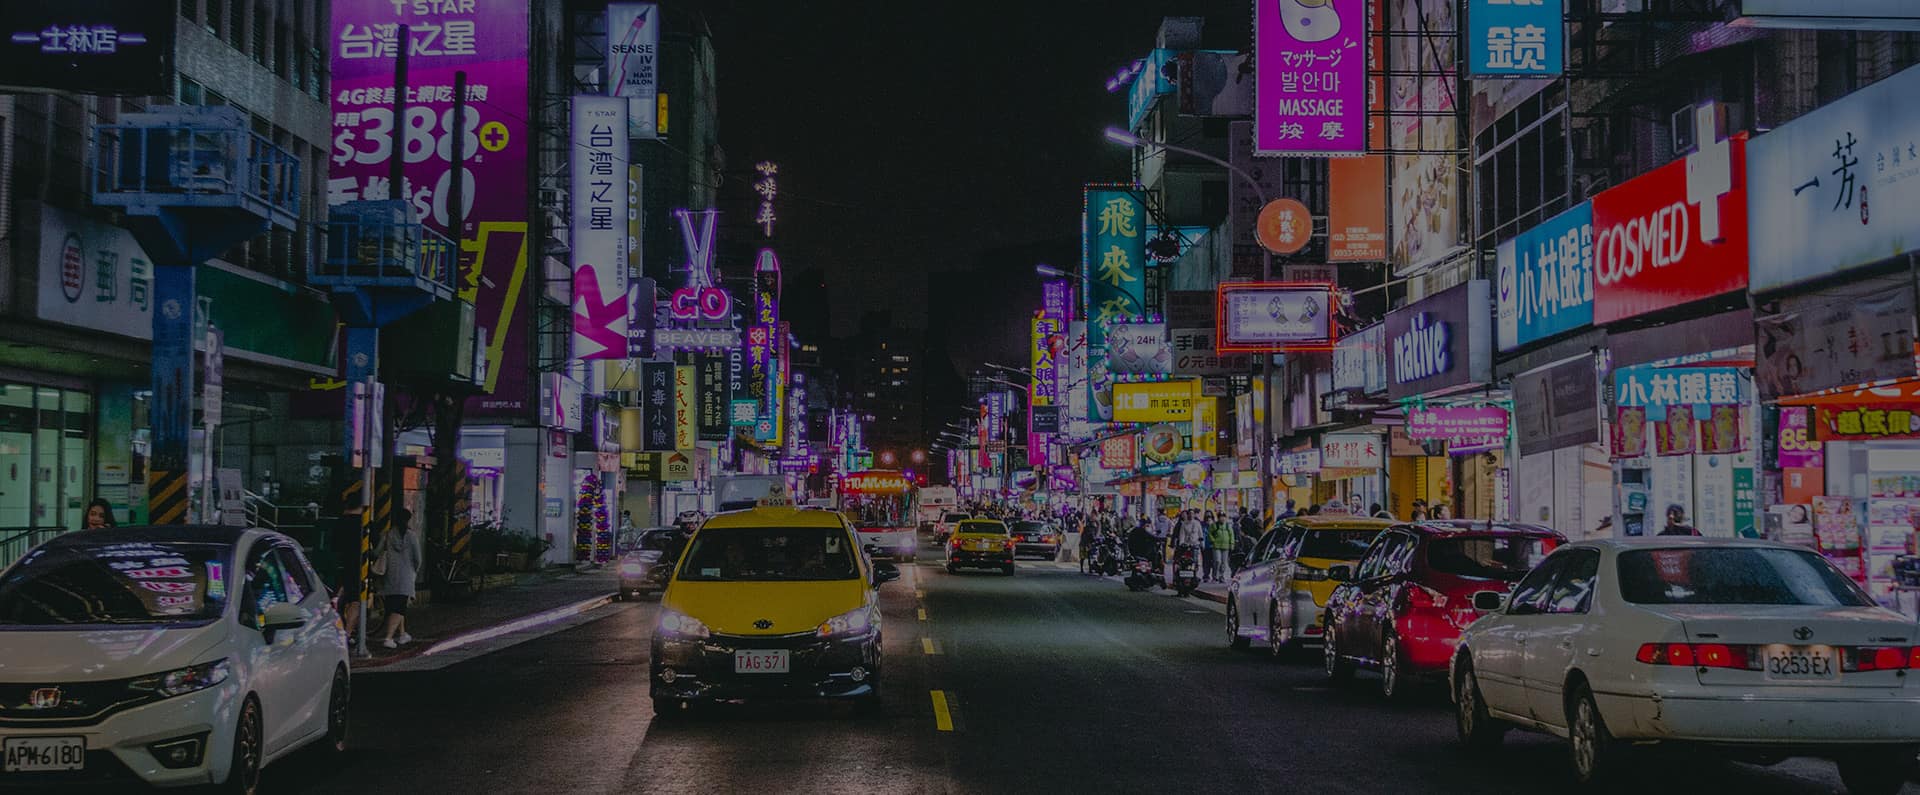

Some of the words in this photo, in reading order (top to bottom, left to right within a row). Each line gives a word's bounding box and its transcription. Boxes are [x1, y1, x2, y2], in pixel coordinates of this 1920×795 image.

[414, 0, 477, 15] STAR
[41, 25, 118, 52] 士林店
[612, 44, 653, 53] SENSE
[640, 55, 653, 64] IV
[1280, 49, 1343, 67] マッサージ
[1281, 71, 1341, 92] 발안마
[1279, 98, 1344, 117] MASSAGE
[1278, 121, 1345, 140] 按摩
[1794, 131, 1858, 212] 一芳
[1595, 200, 1690, 286] COSMED
[96, 249, 149, 312] 郵局
[657, 332, 733, 346] BEAVER
[1136, 335, 1156, 345] 24H
[1393, 311, 1448, 384] native
[1620, 372, 1739, 406] 小林眼鏡
[734, 402, 757, 425] 藥
[669, 464, 688, 472] ERA
[6, 745, 83, 766] APM-6180
